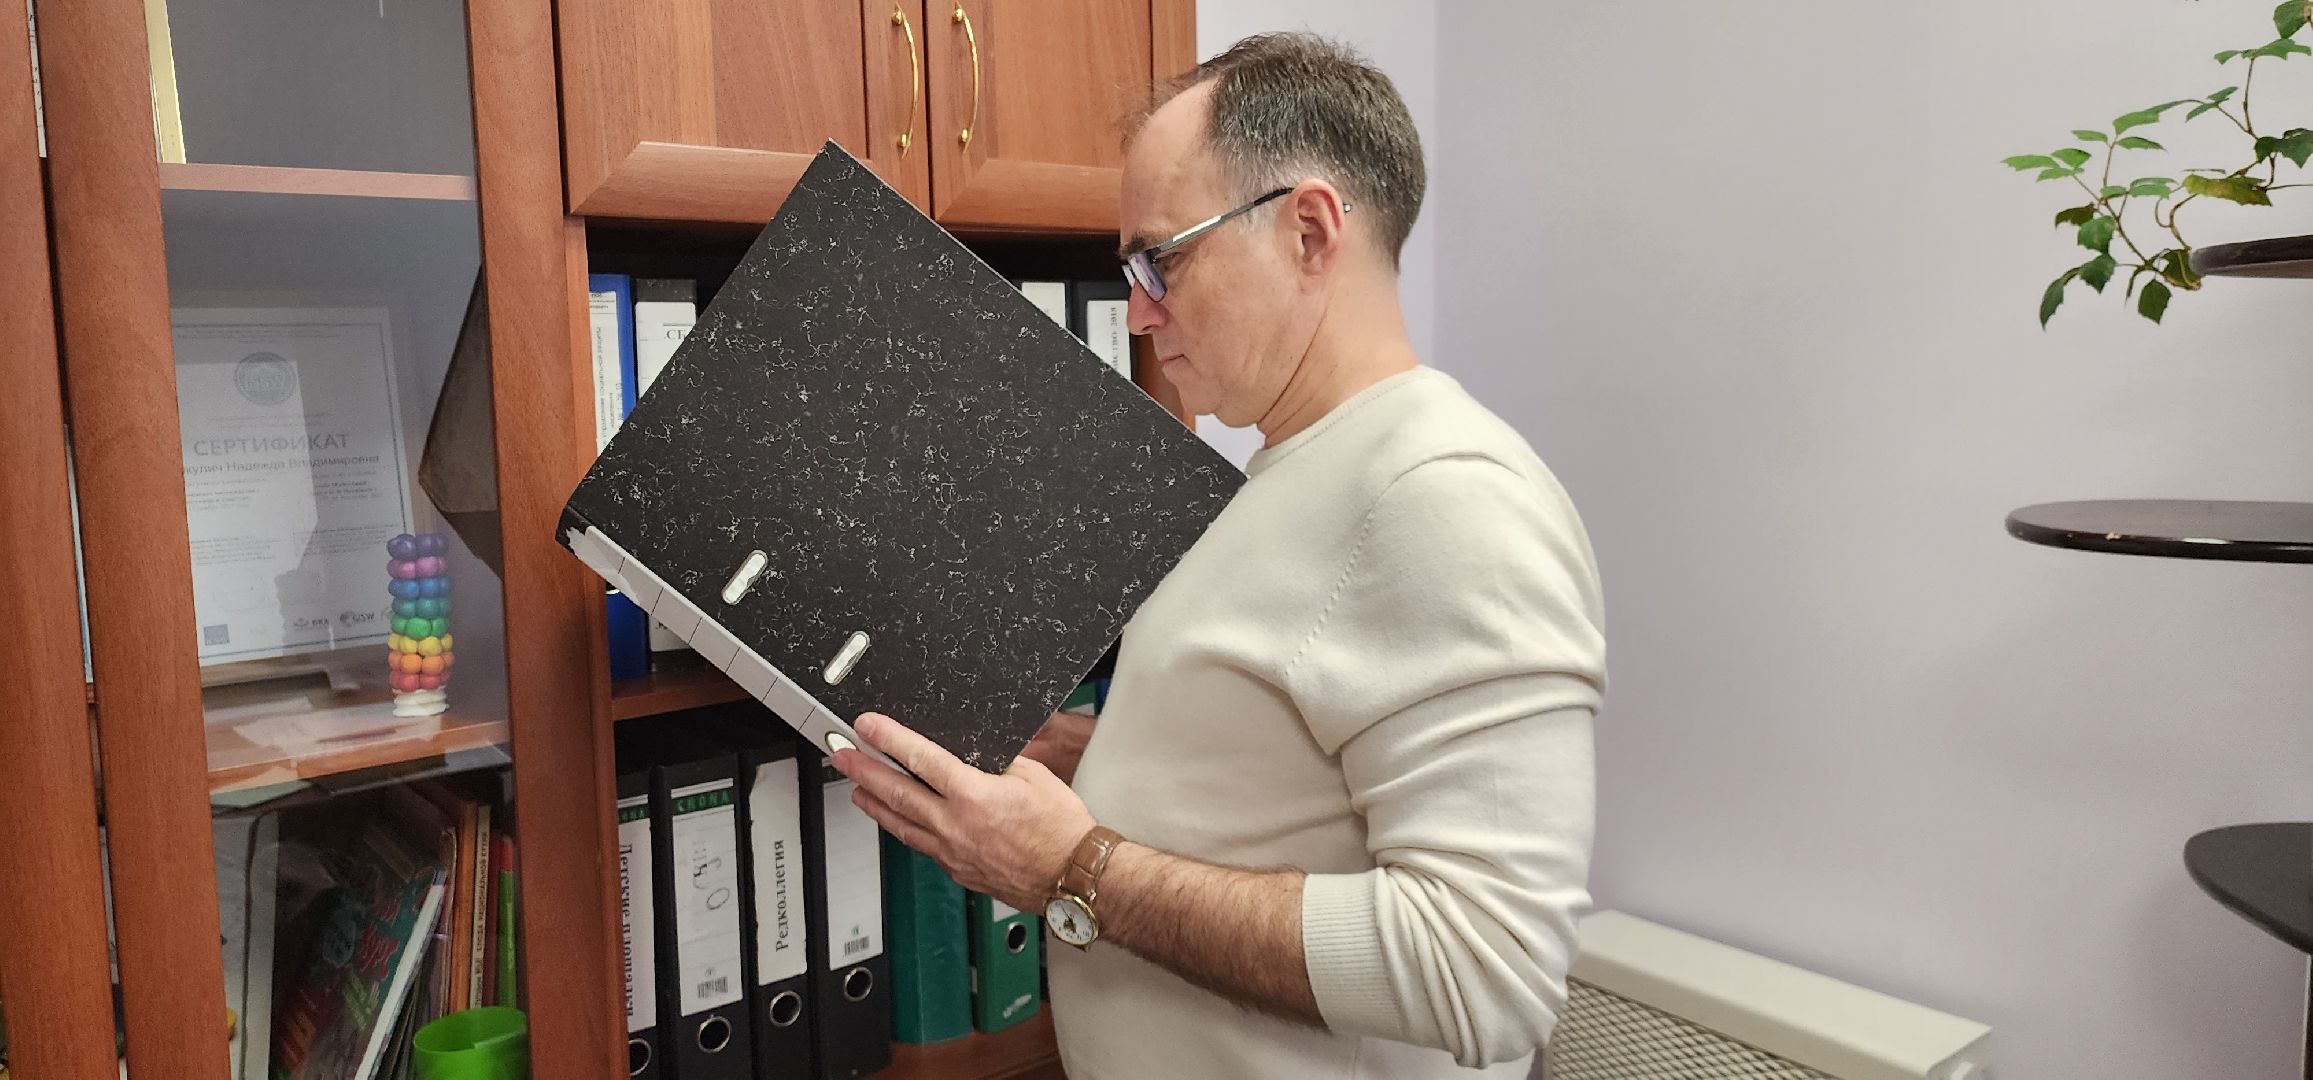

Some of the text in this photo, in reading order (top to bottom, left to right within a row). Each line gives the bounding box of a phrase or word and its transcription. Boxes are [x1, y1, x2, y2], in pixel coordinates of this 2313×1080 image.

[193, 433, 350, 457] СЕРТИФИКАТ
[226, 460, 286, 474] Надежда
[288, 455, 380, 470] Владимировна
[774, 839, 789, 953] Редколлегия
